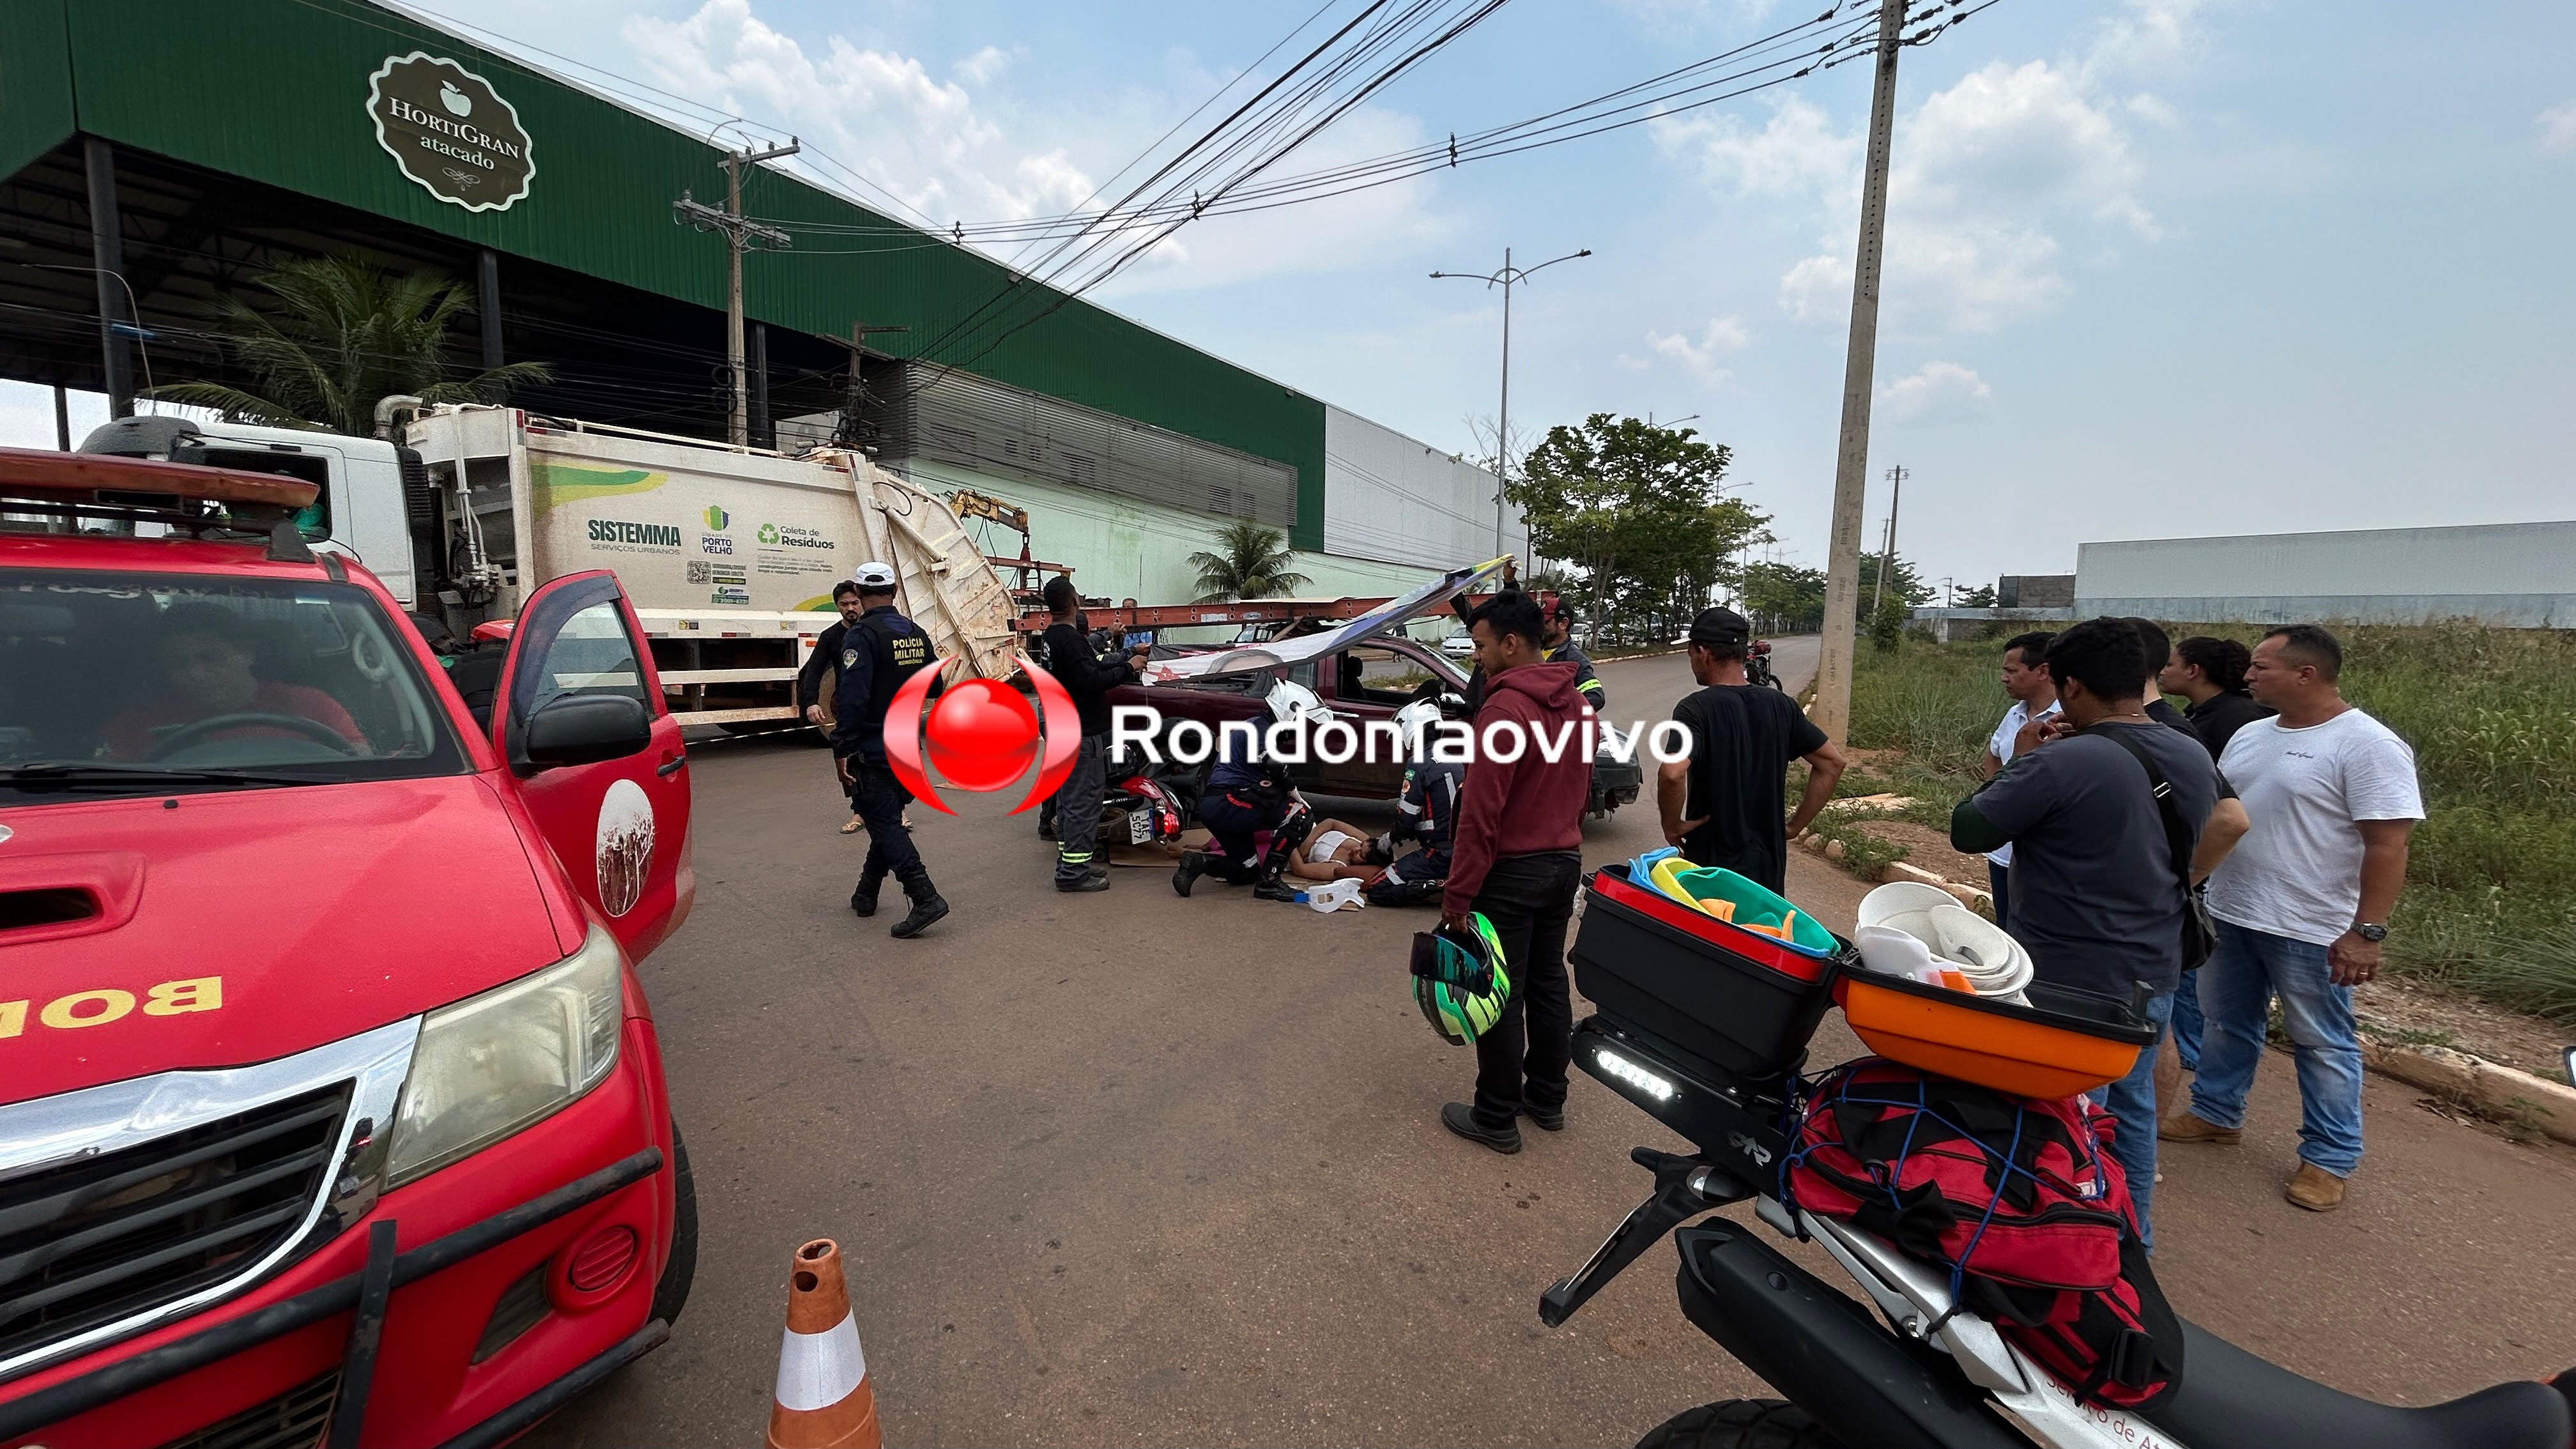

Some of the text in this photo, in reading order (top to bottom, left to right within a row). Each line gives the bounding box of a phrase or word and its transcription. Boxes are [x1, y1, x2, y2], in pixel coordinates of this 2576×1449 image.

[420, 135, 495, 170] atacado
[588, 519, 682, 546] SISTEMMA
[780, 526, 806, 535] Coleta
[702, 537, 732, 547] PORTO
[781, 535, 835, 549] Resíduos
[591, 544, 680, 555] SERVIÇOS URBANOS
[702, 546, 732, 555] VELHO
[893, 636, 924, 649] POLÍCIA
[894, 648, 925, 660] MILITAR
[1140, 816, 1150, 836] TAE
[2113, 1418, 2135, 1443] de
